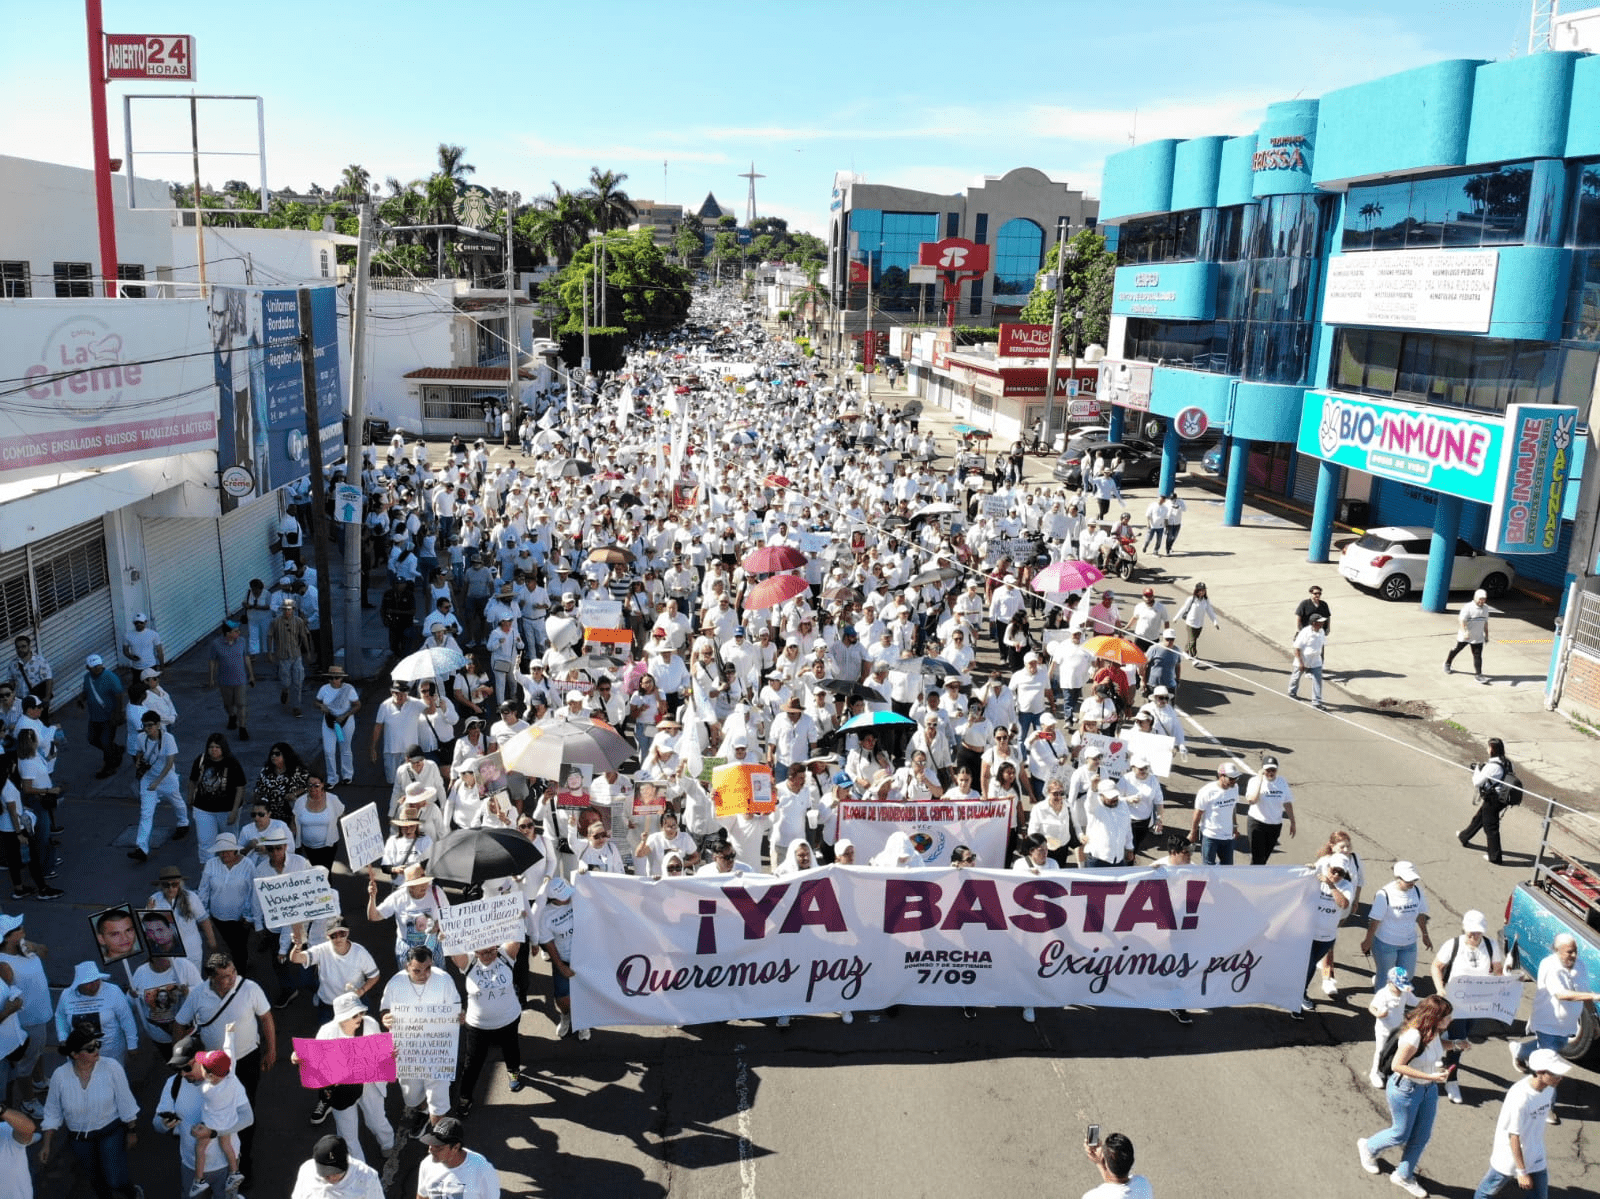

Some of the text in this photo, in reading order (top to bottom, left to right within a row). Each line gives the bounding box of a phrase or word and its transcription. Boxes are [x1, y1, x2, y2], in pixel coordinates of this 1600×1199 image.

[108, 43, 145, 69] ABIERTO
[147, 38, 187, 64] 24
[147, 65, 187, 74] HORAS
[267, 298, 296, 312] Uniformes
[1011, 328, 1052, 342] My Piel
[60, 344, 88, 366] La
[24, 361, 143, 400] Creme
[2, 420, 213, 460] COMIDAS ENSALADAS GUISOS TAQUIZAS LACTEOS
[868, 806, 877, 821] DE
[918, 806, 930, 821] DEL
[930, 806, 954, 821] CENTRO
[957, 806, 966, 820] DE
[258, 876, 312, 892] Abandoné
[264, 893, 300, 906] HOGAR
[440, 896, 518, 920] El miedo que se
[441, 919, 462, 932] vive
[463, 917, 475, 928] en
[695, 877, 1207, 955] ¡YA BASTA!
[904, 950, 992, 964] MARCHA
[918, 970, 976, 985] 7/09
[1036, 940, 1263, 996] Exigimos paz
[616, 954, 873, 1003] Queremos paz
